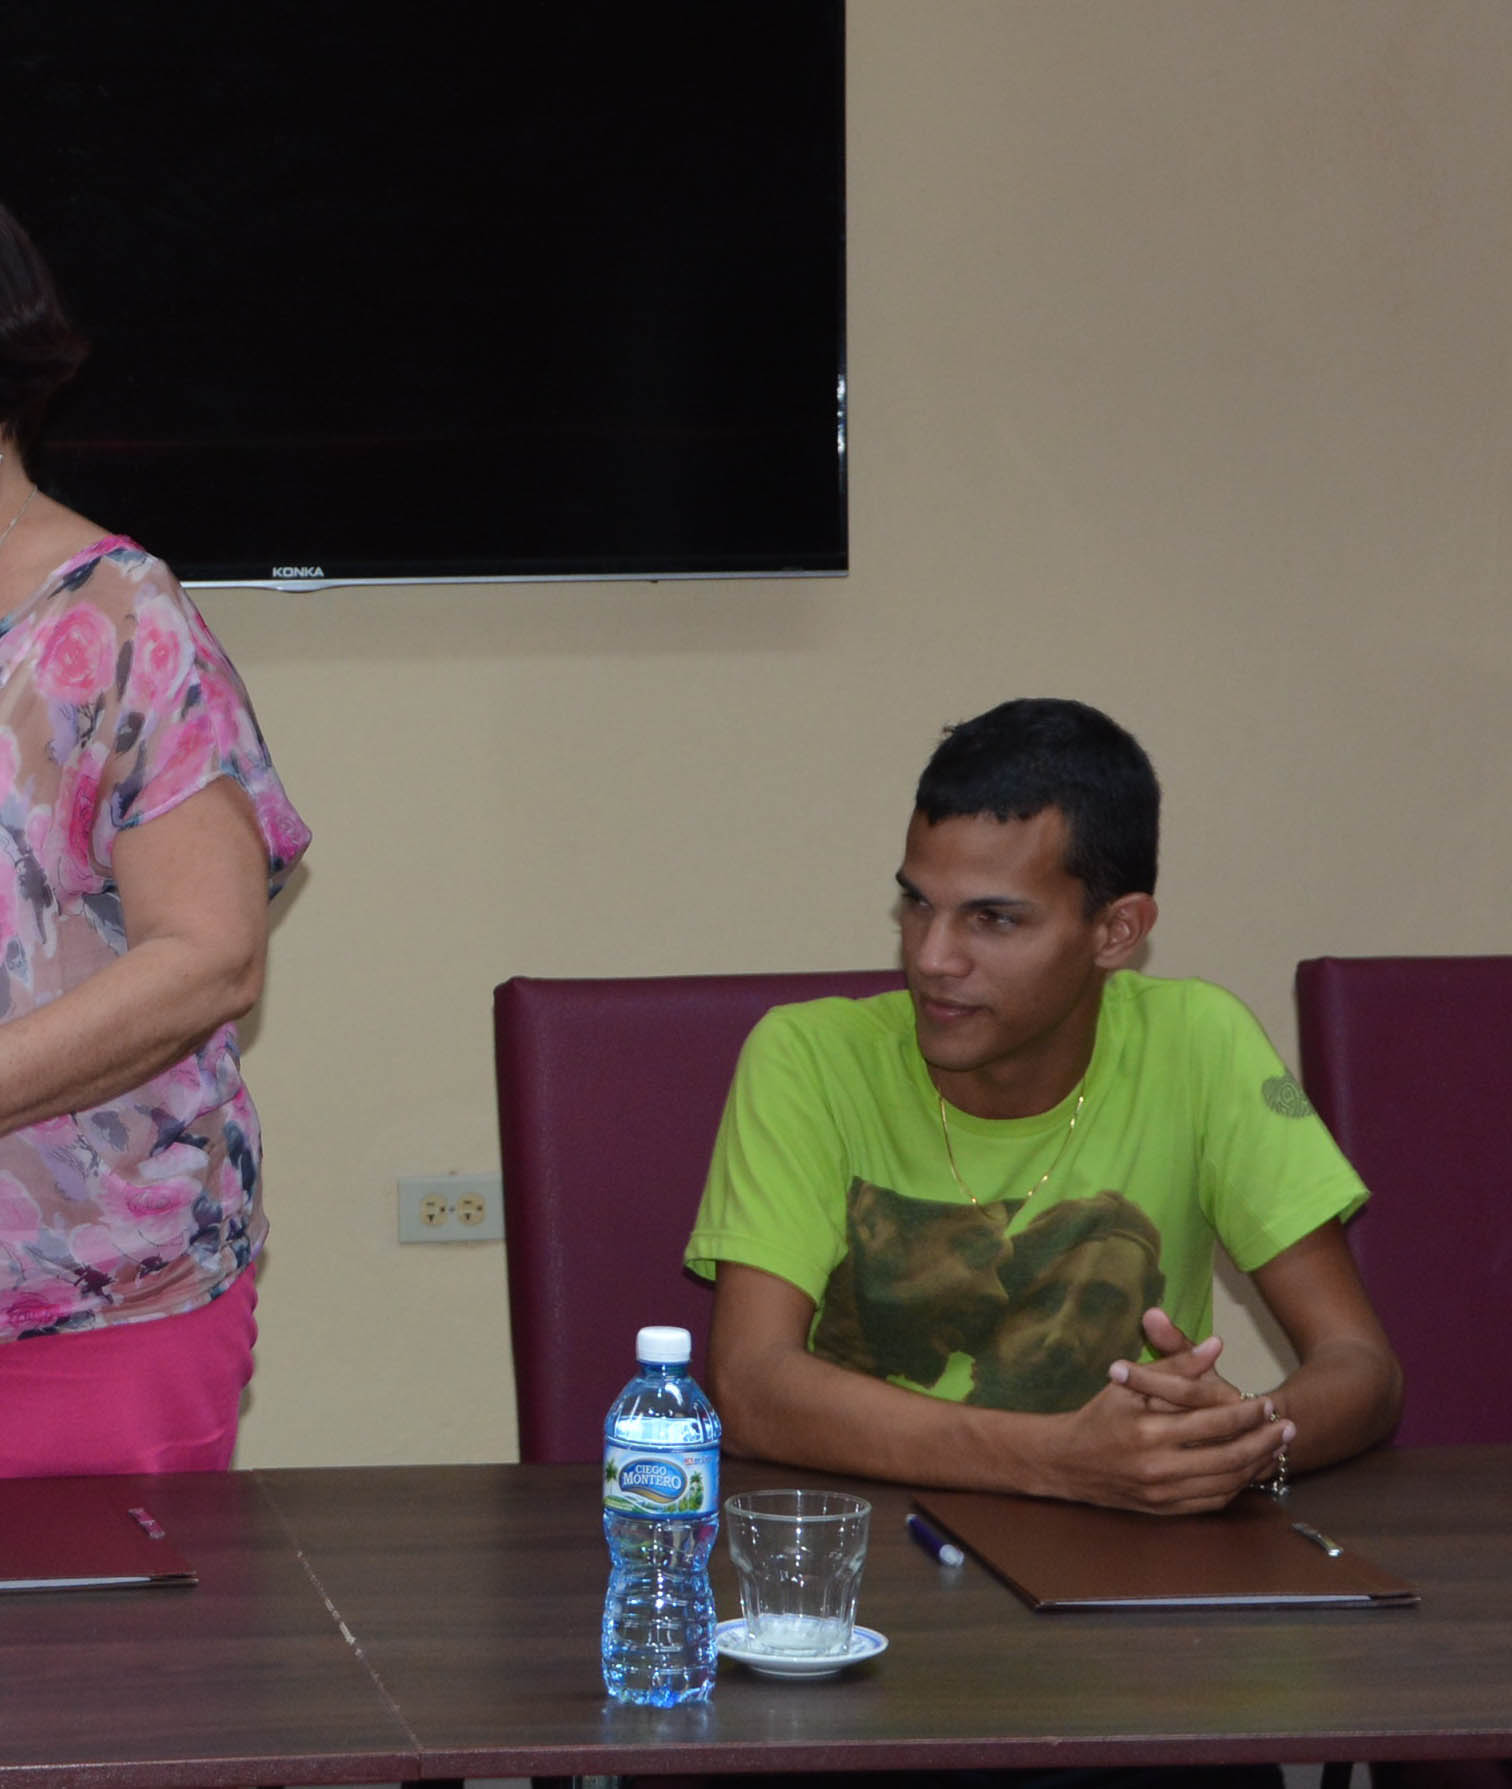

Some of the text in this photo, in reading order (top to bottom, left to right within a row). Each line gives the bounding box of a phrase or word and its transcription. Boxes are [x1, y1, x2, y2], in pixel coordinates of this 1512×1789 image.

[272, 566, 324, 577] KONKA
[635, 1464, 667, 1475] CIEGO
[622, 1471, 682, 1490] MONTERO
